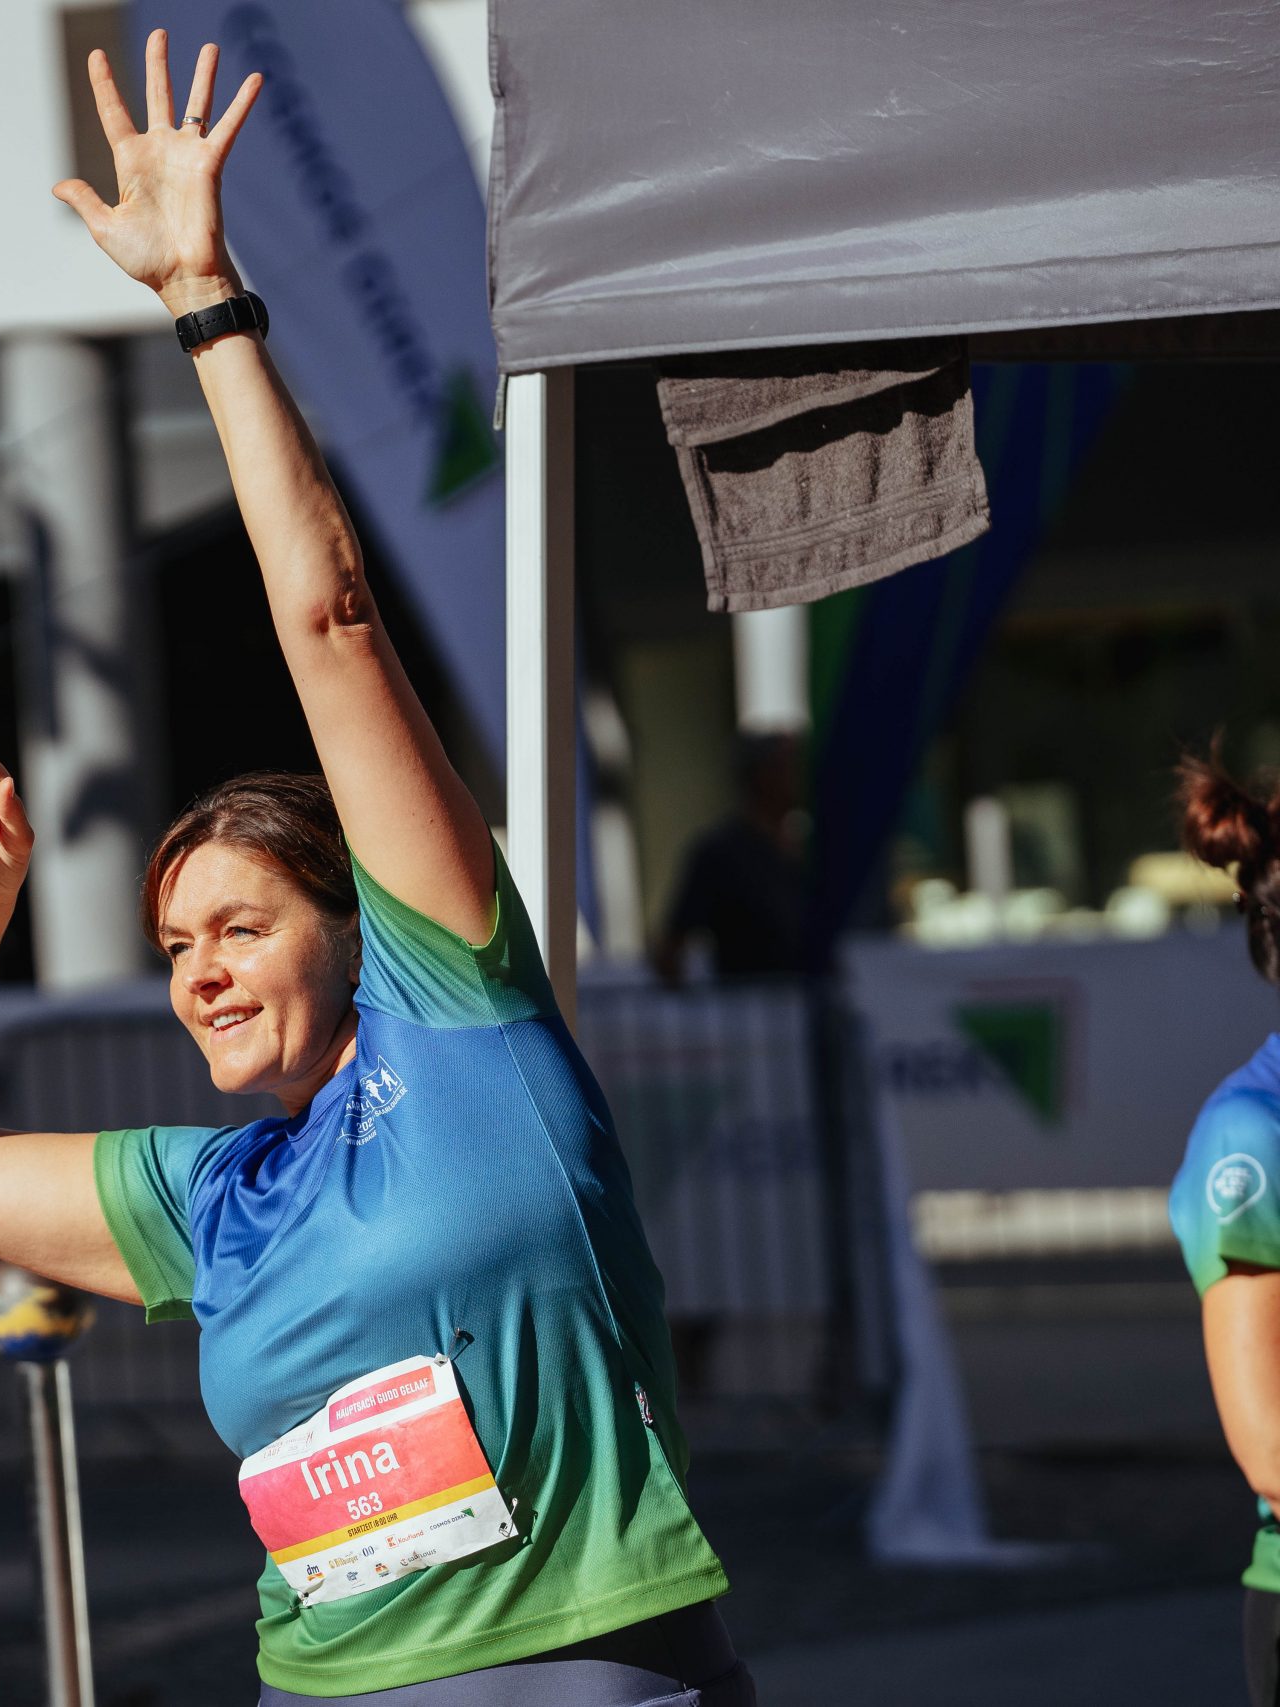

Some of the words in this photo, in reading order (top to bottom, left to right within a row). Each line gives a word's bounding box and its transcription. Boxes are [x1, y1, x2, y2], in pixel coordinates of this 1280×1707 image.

[335, 1395, 376, 1421] HAUPTSACH
[377, 1387, 399, 1406] GUDD
[400, 1377, 429, 1397] GELAAF
[300, 1441, 400, 1500] Irina
[346, 1492, 383, 1520] 563
[347, 1521, 373, 1537] STARTZEIT
[386, 1512, 398, 1523] UHR
[429, 1518, 451, 1531] COSMOS
[306, 1564, 320, 1576] dm
